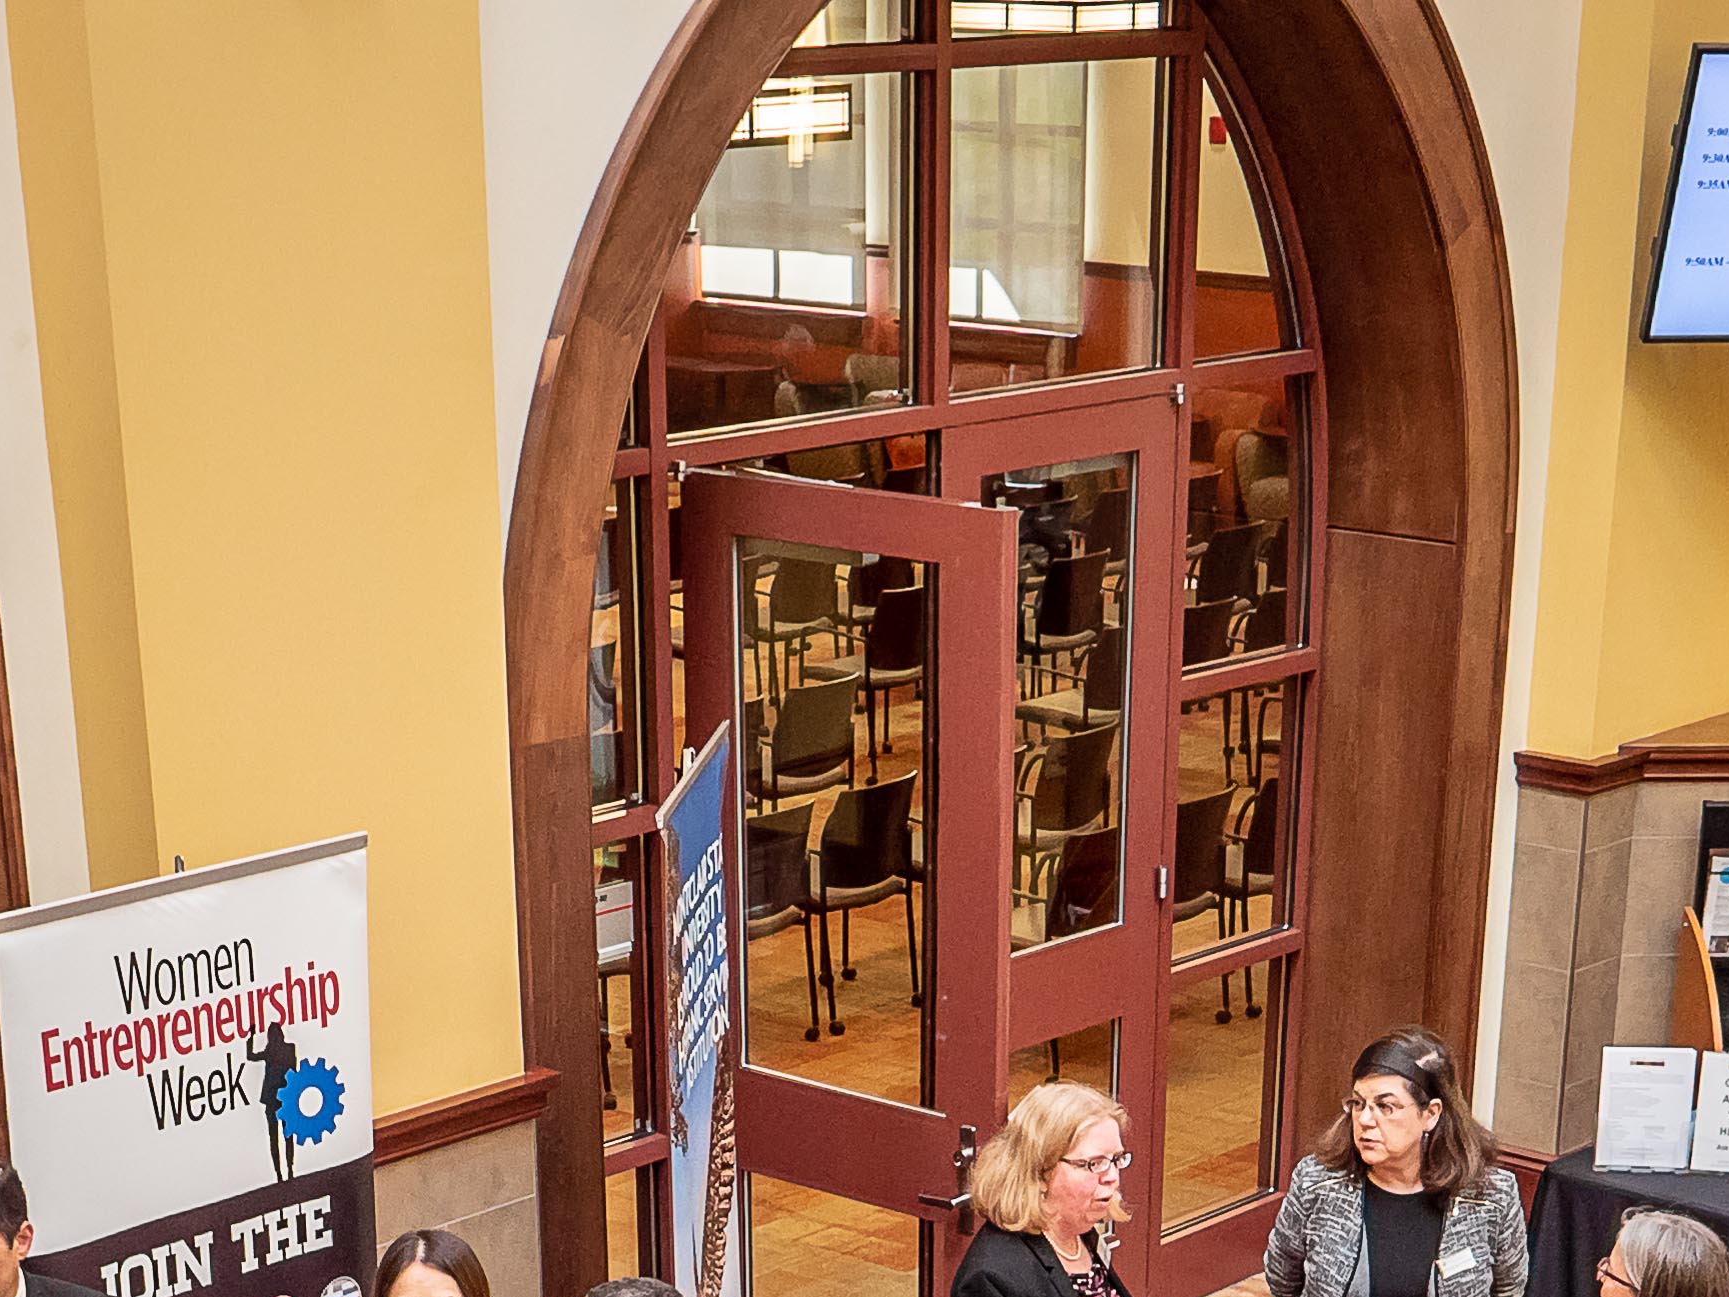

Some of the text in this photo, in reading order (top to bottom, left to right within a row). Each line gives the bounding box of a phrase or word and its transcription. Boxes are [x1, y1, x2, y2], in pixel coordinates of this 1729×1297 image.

[113, 936, 256, 1015] Women
[40, 960, 341, 1094] Entrepreneurship
[146, 1052, 251, 1132] Week
[230, 1194, 335, 1275] THE
